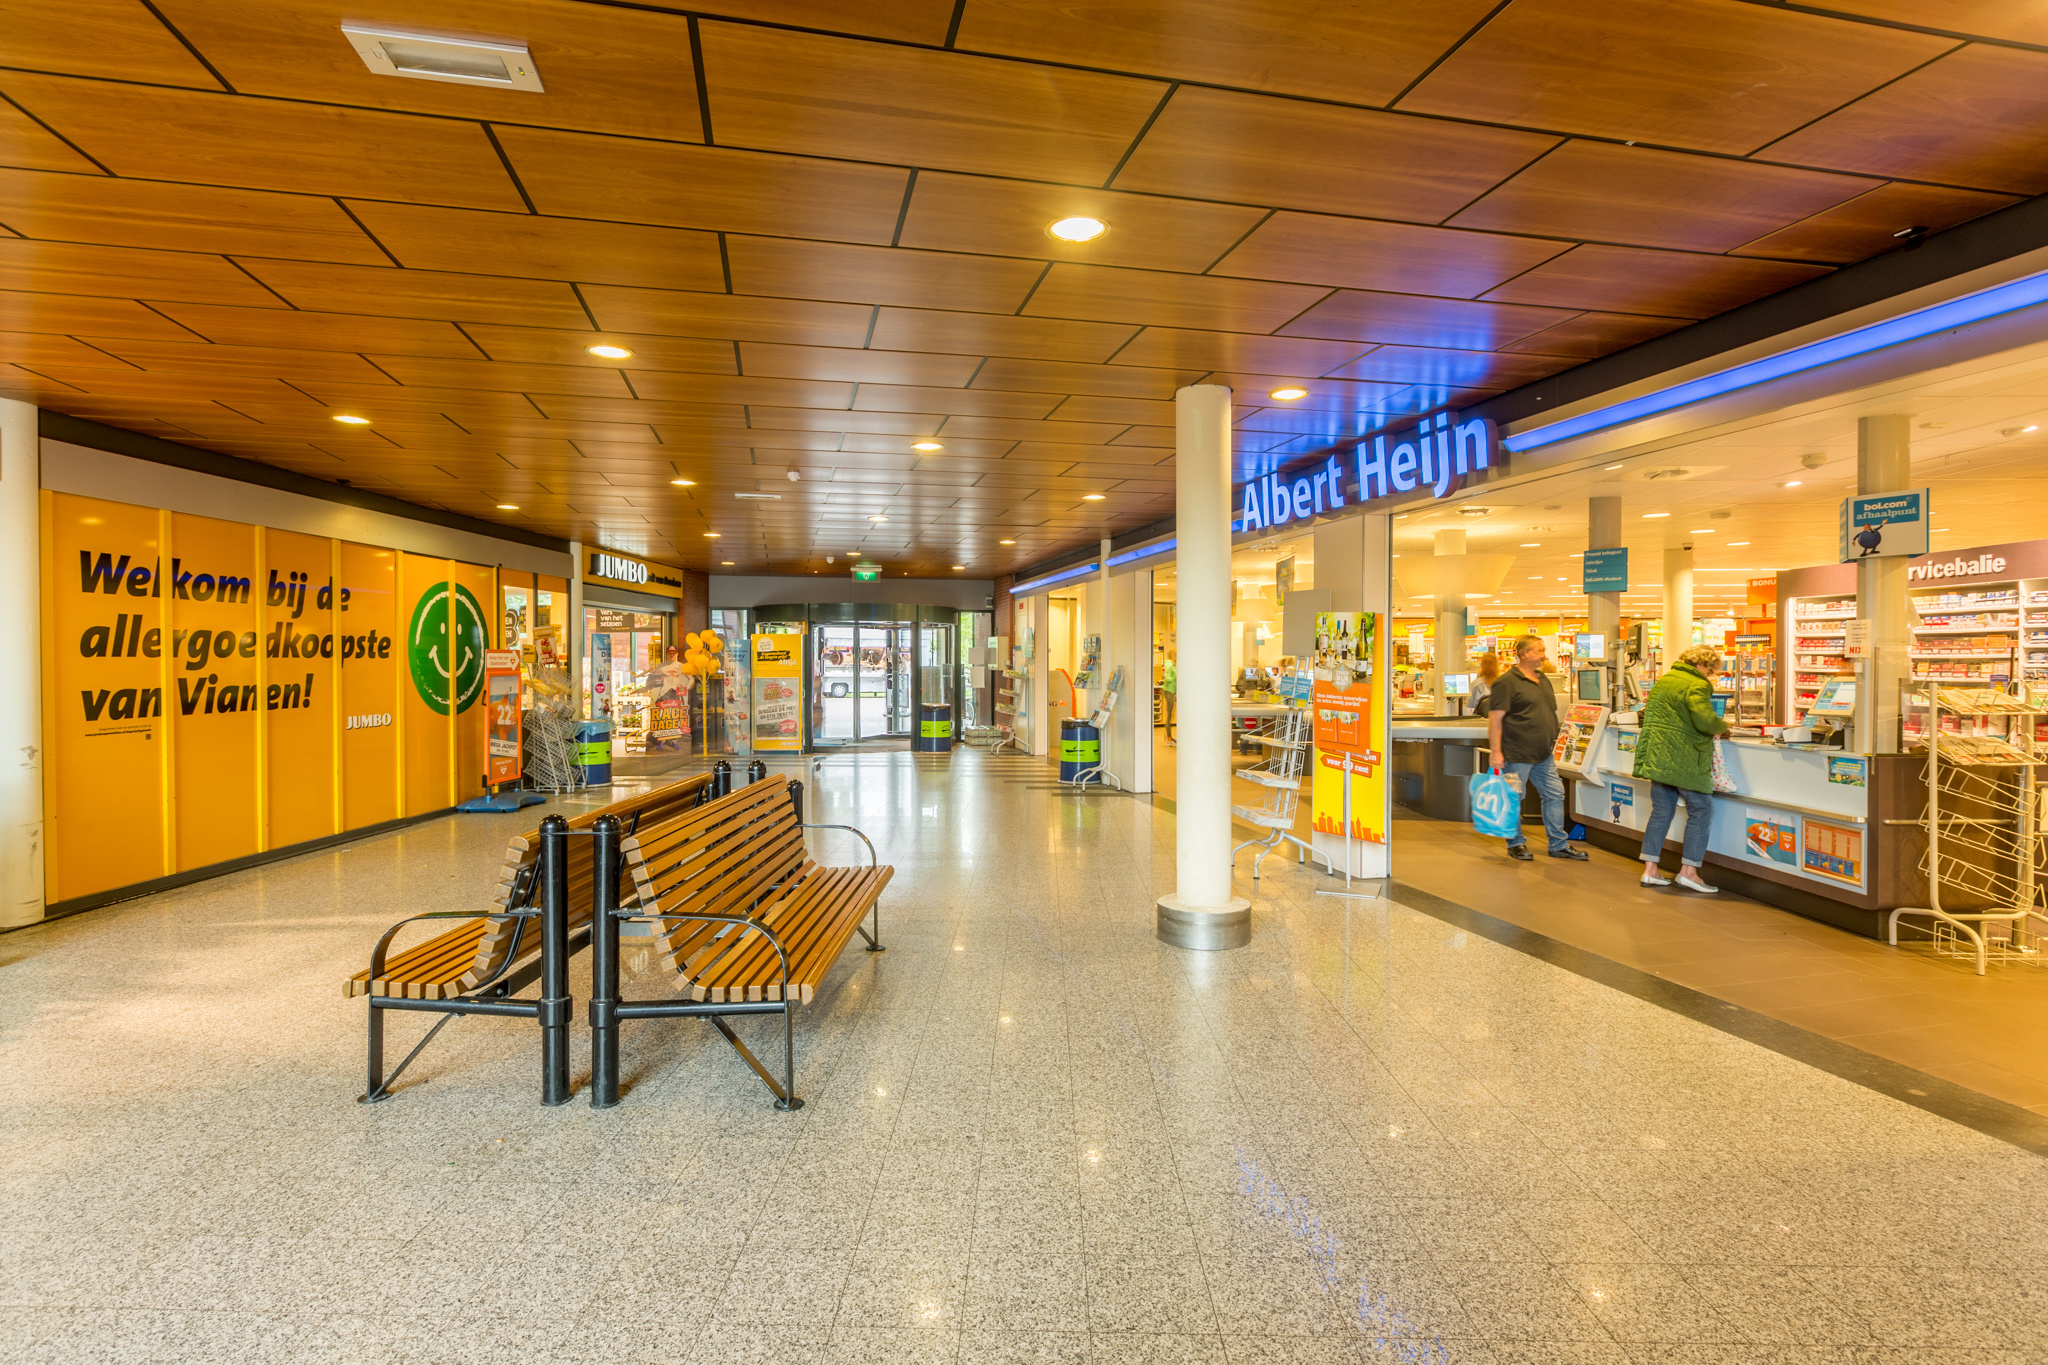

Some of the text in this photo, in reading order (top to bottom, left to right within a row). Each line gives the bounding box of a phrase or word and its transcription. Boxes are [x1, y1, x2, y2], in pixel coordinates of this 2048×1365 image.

[1242, 411, 1488, 533] Albert Heijn
[1856, 507, 1917, 520] afhaalpunt
[1864, 501, 1907, 511] bol.com
[597, 553, 648, 584] JUMBO
[79, 550, 351, 619] Welkom bij de
[80, 613, 391, 671] allergoedkoopste
[81, 673, 314, 721] van Vianen!
[651, 706, 688, 720] RACE
[346, 713, 392, 730] JUMBO
[651, 718, 688, 731] DAGEN
[1326, 758, 1341, 766] voor
[1354, 764, 1369, 774] cent
[1614, 786, 1630, 794] bol.com
